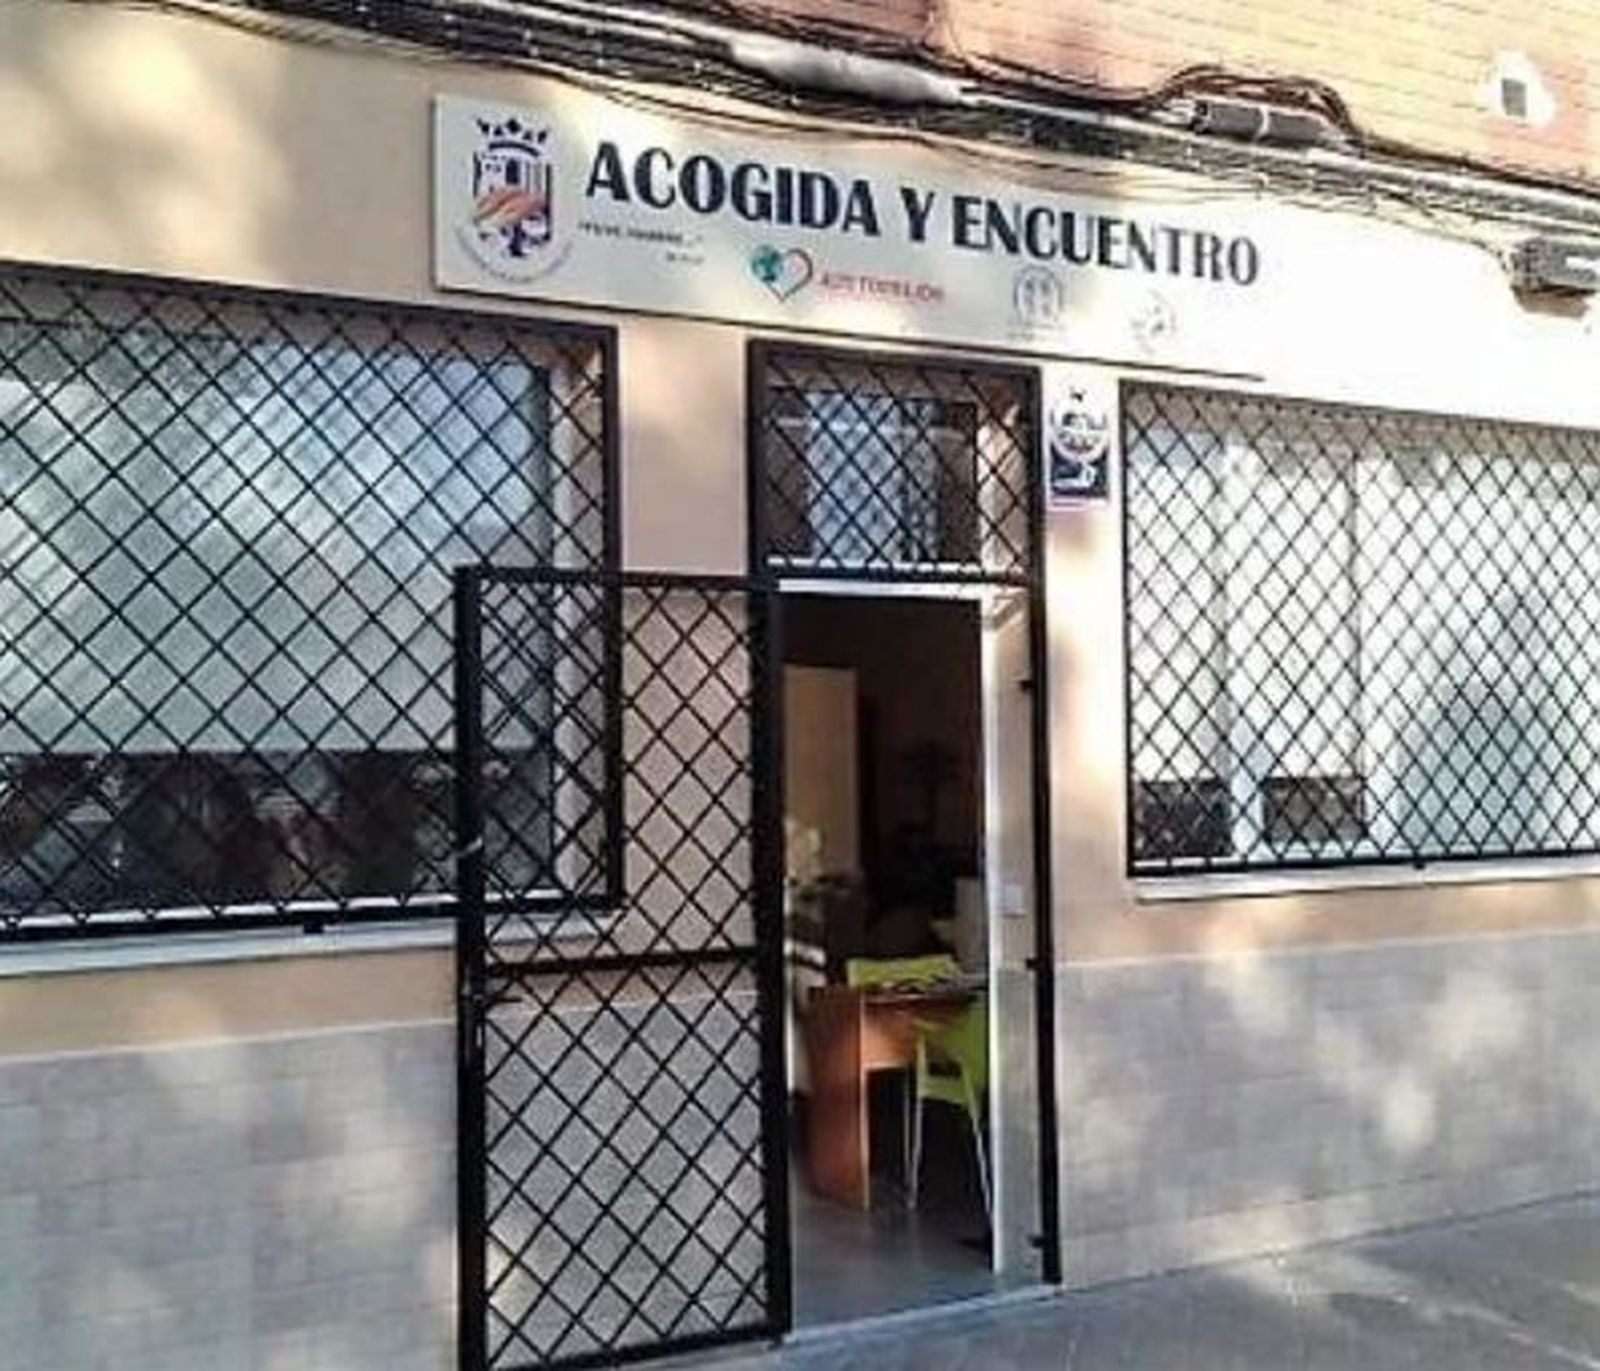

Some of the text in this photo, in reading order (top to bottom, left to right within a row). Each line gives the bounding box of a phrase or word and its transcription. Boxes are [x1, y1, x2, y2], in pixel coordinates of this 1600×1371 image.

[586, 141, 1259, 286] ACOGIDA Y ENCUENTRO
